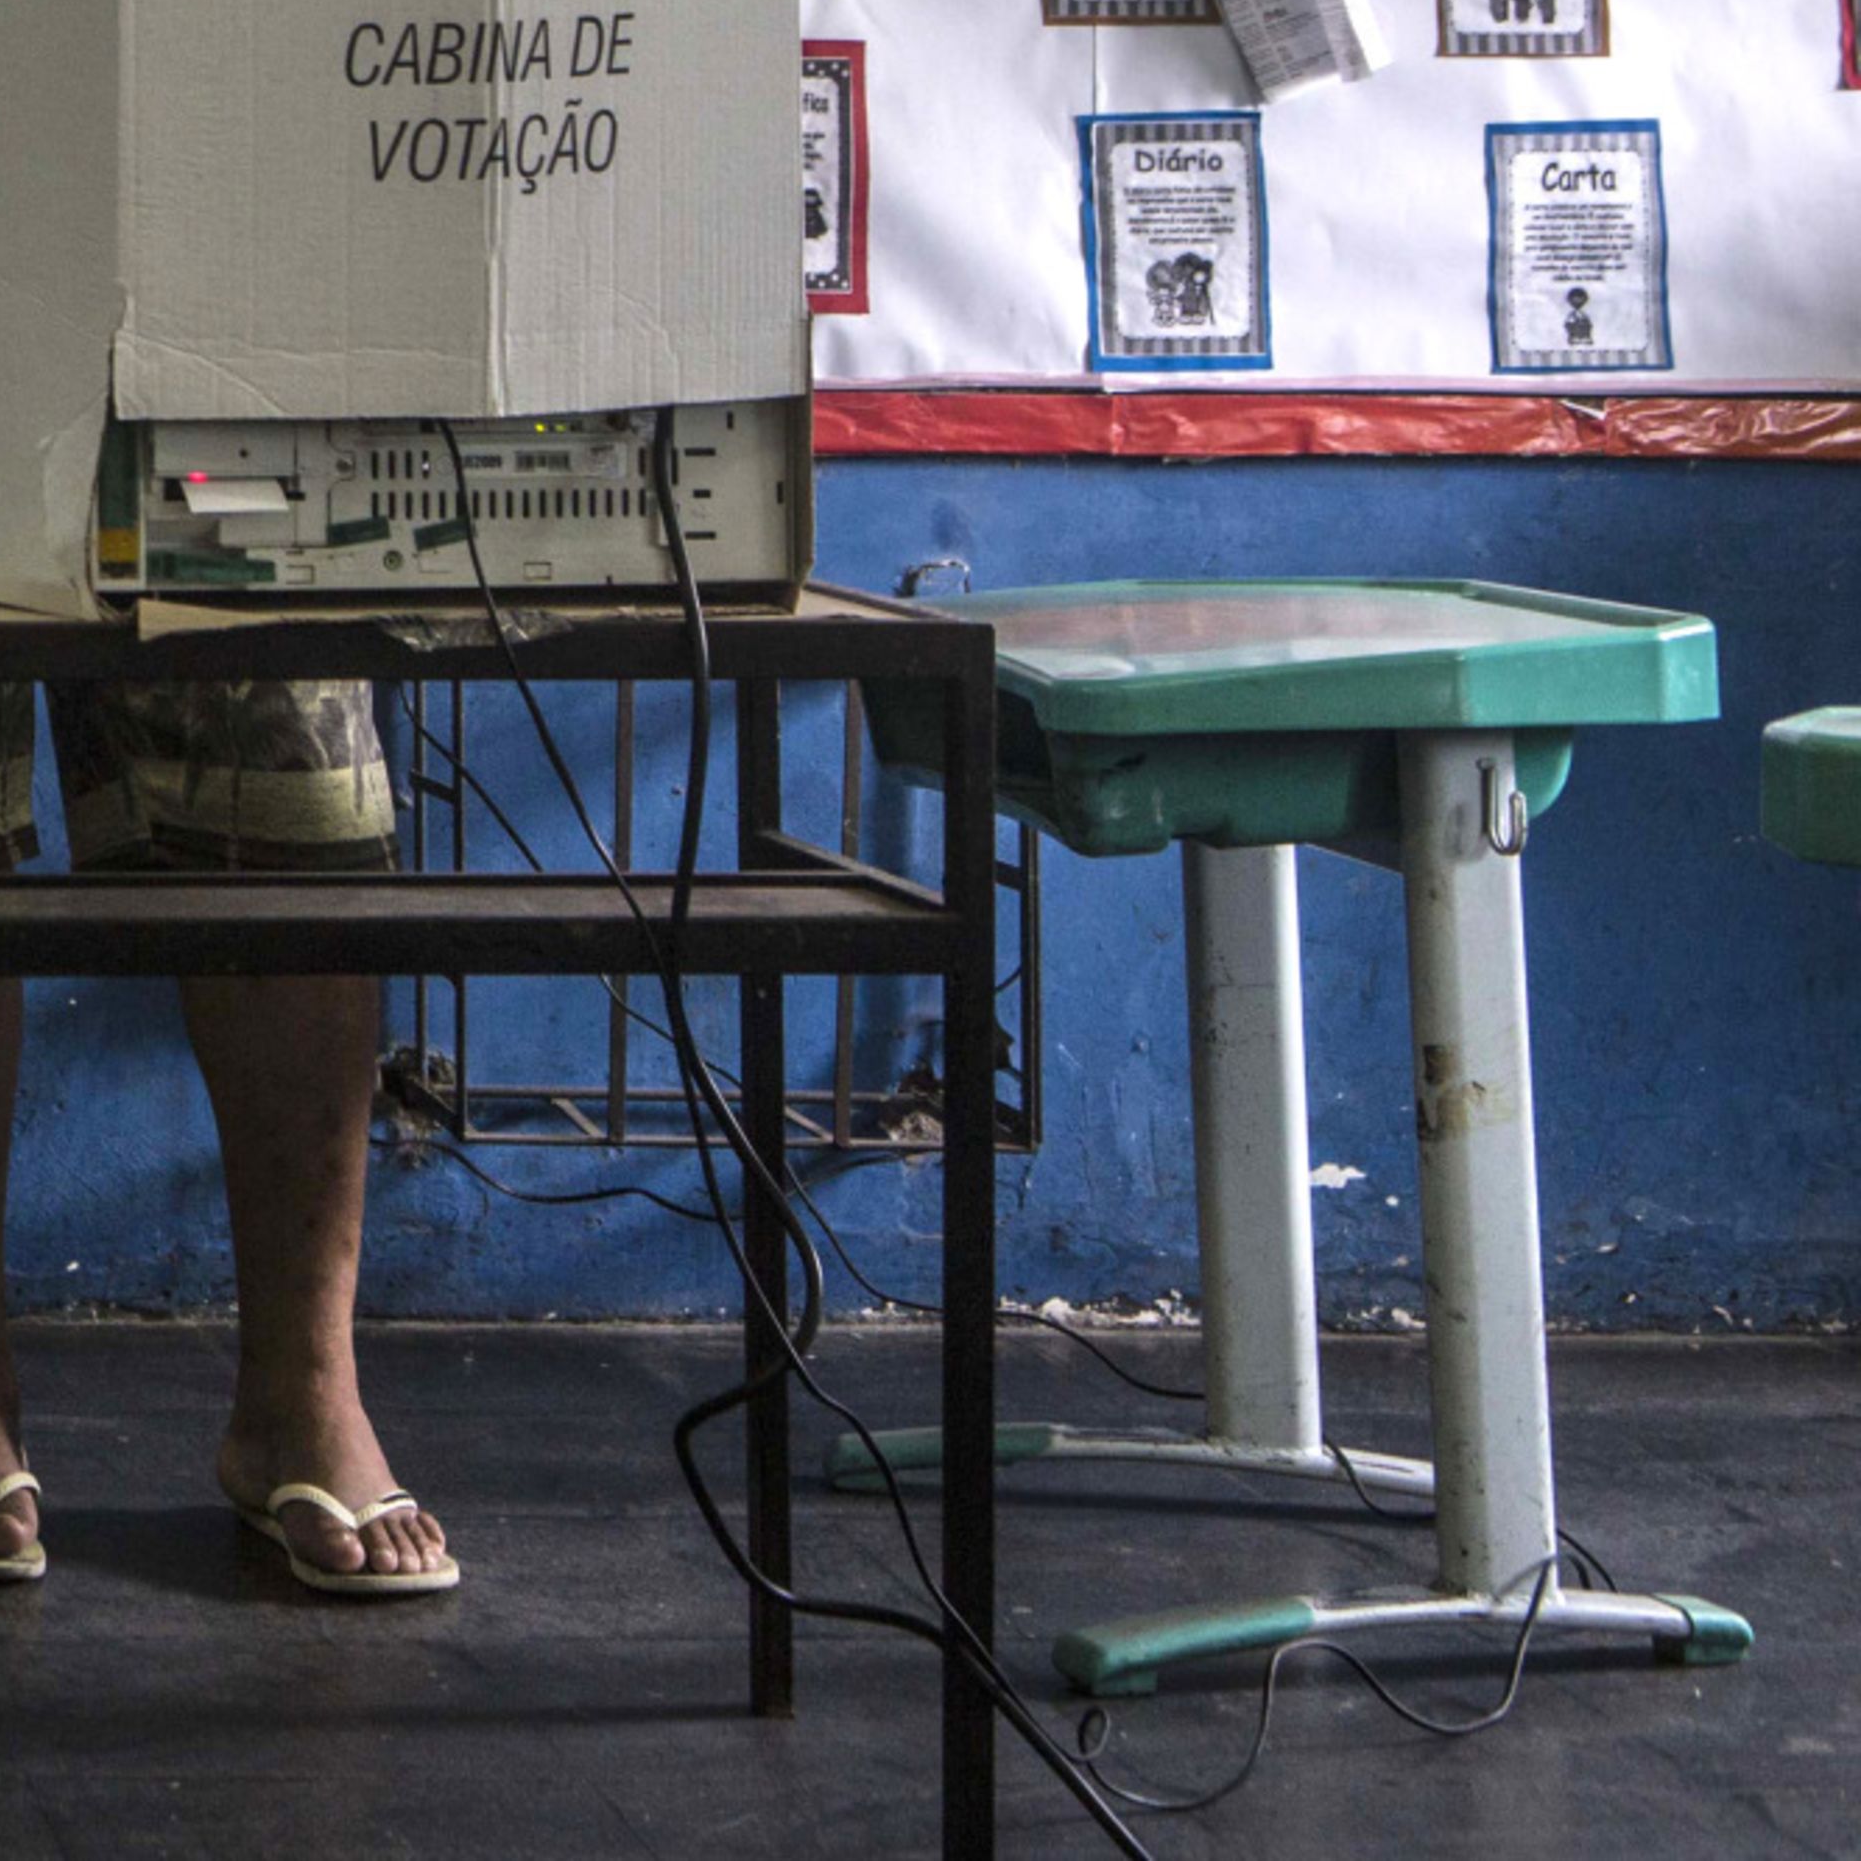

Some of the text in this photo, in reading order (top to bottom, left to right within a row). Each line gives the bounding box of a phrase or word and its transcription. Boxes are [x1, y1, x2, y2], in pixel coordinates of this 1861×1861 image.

[344, 12, 635, 87] CABINA DE
[367, 99, 618, 194] VOTAÇÃO
[1134, 146, 1223, 174] Diário
[1540, 160, 1617, 195] Carta
